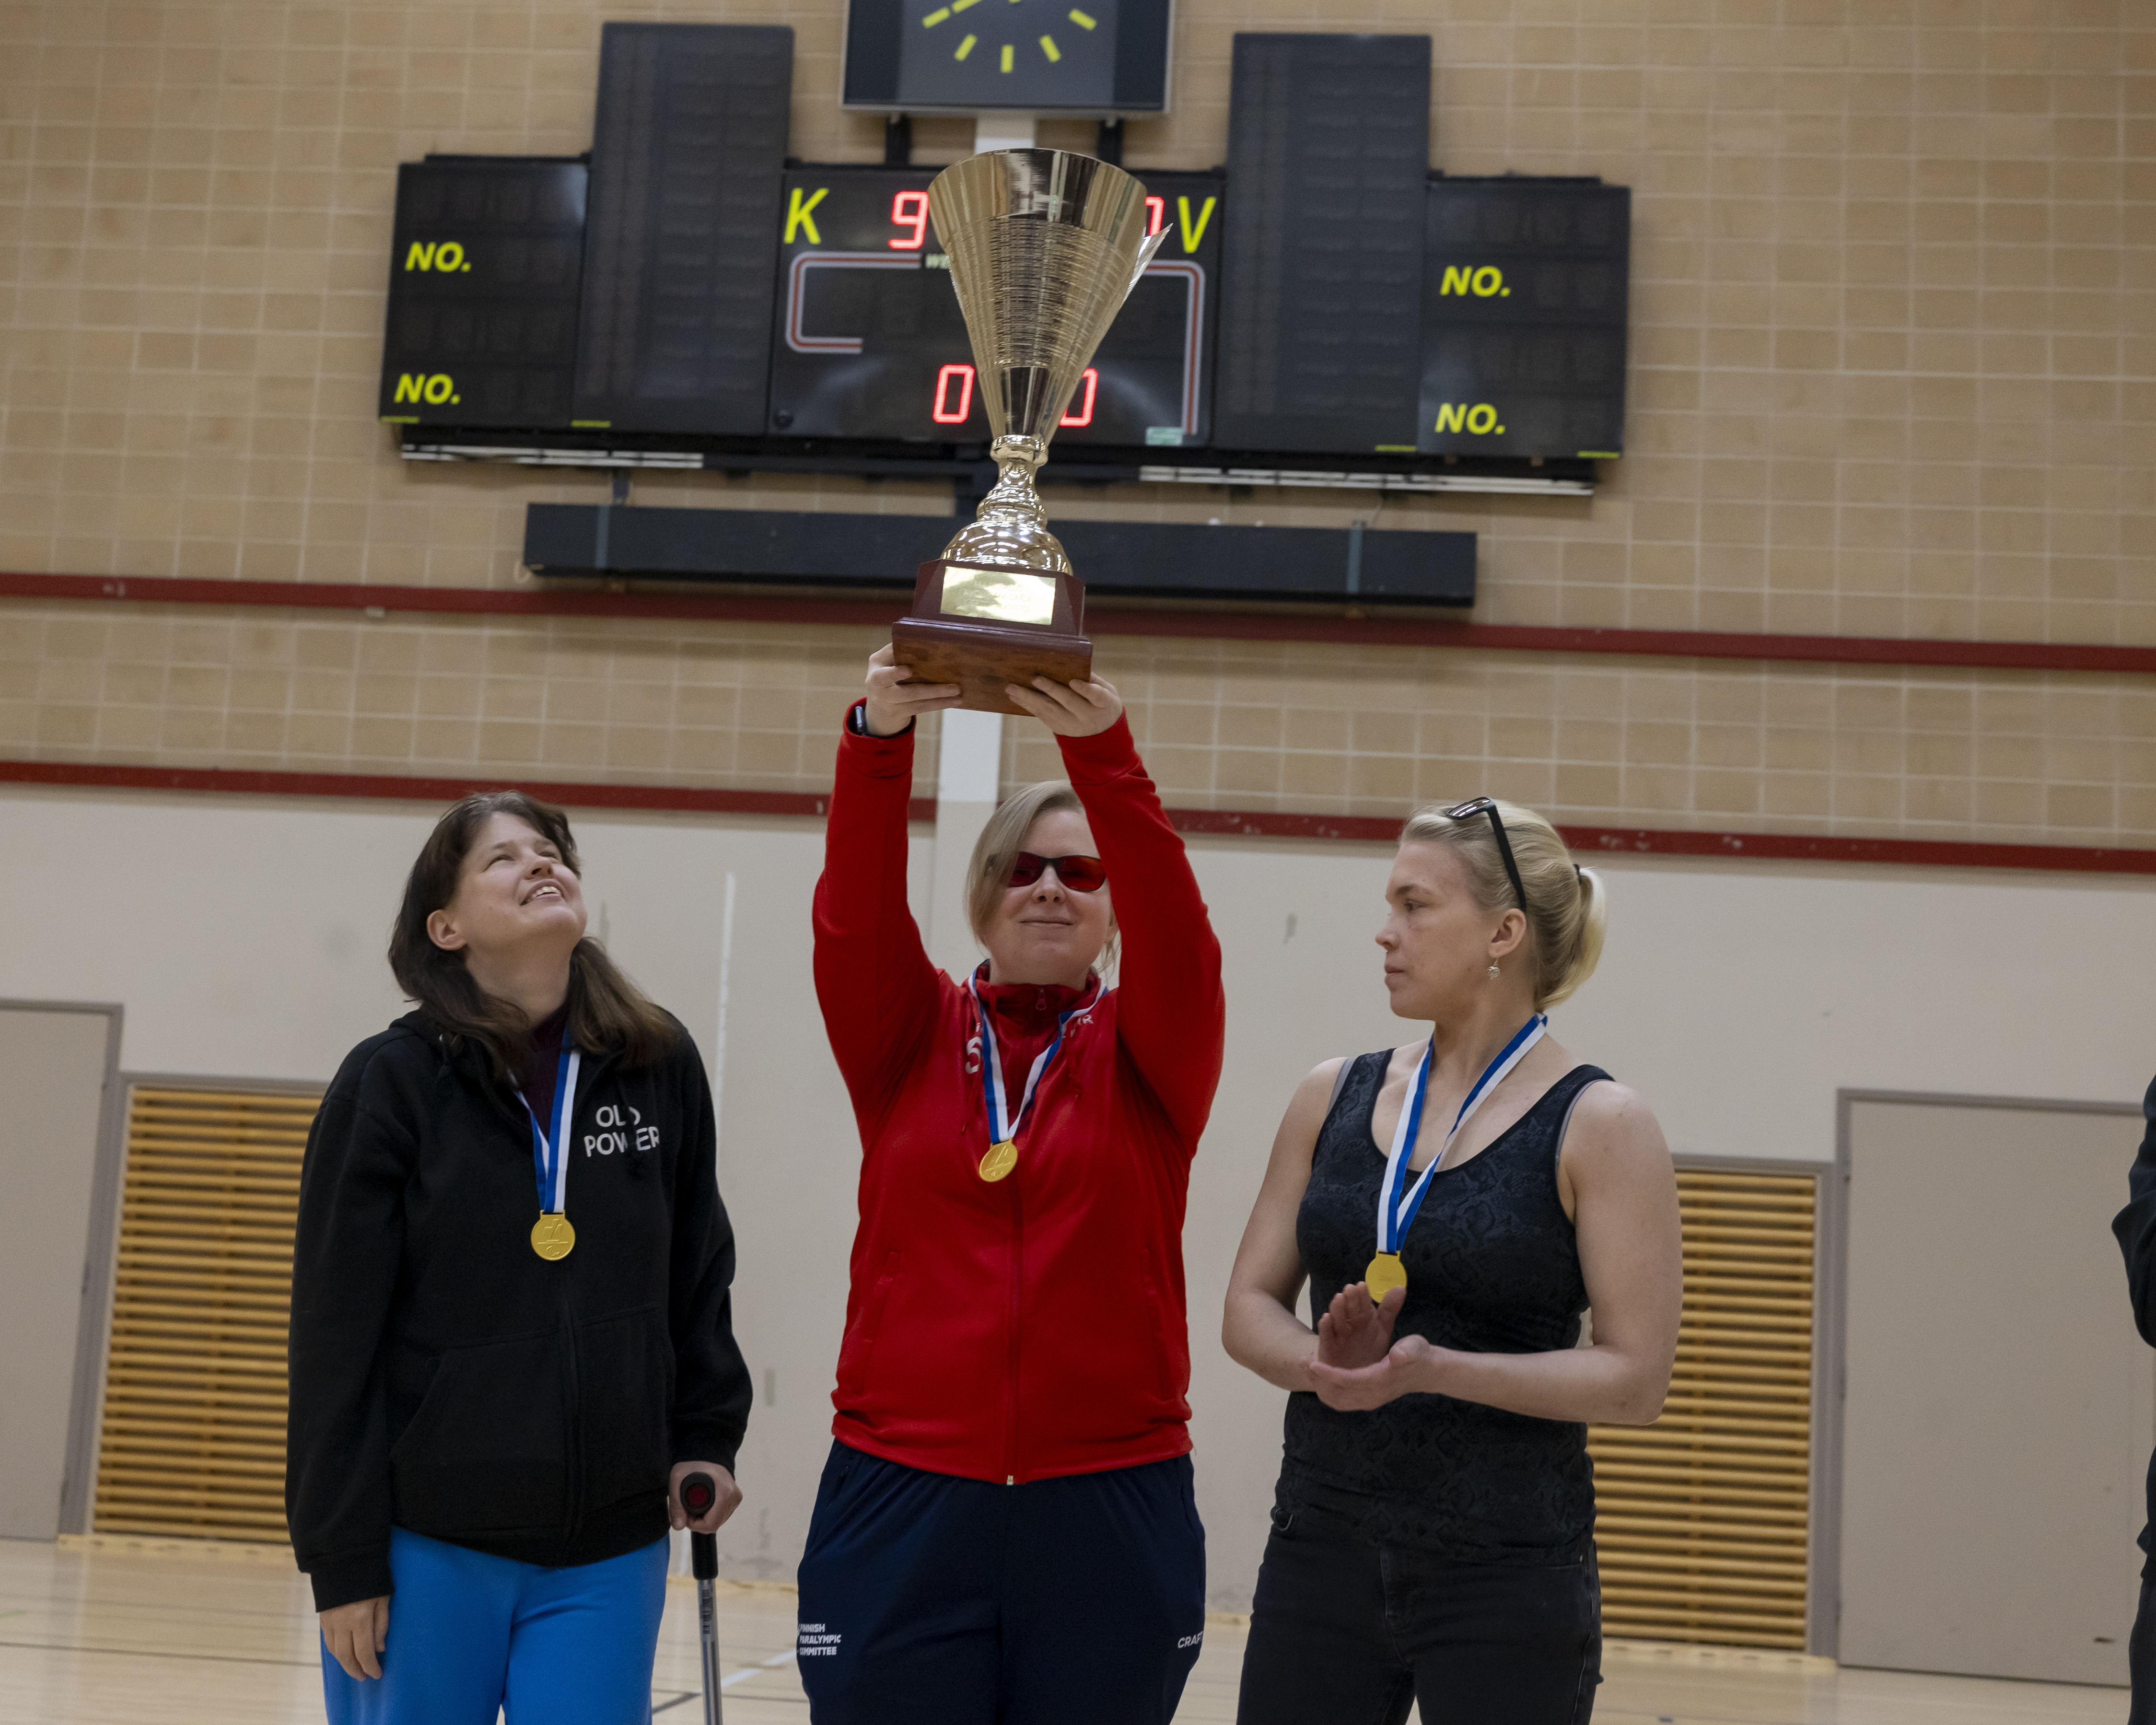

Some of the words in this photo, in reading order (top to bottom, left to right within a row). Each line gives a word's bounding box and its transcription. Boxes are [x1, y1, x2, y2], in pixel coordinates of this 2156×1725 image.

[784, 188, 828, 244] K
[1177, 197, 1216, 253] V
[406, 242, 471, 271] NO.
[1441, 266, 1510, 297] NO.
[395, 374, 460, 404] NO.
[932, 364, 975, 424] 0
[1435, 404, 1505, 434] NO.
[583, 1126, 660, 1157] POWER
